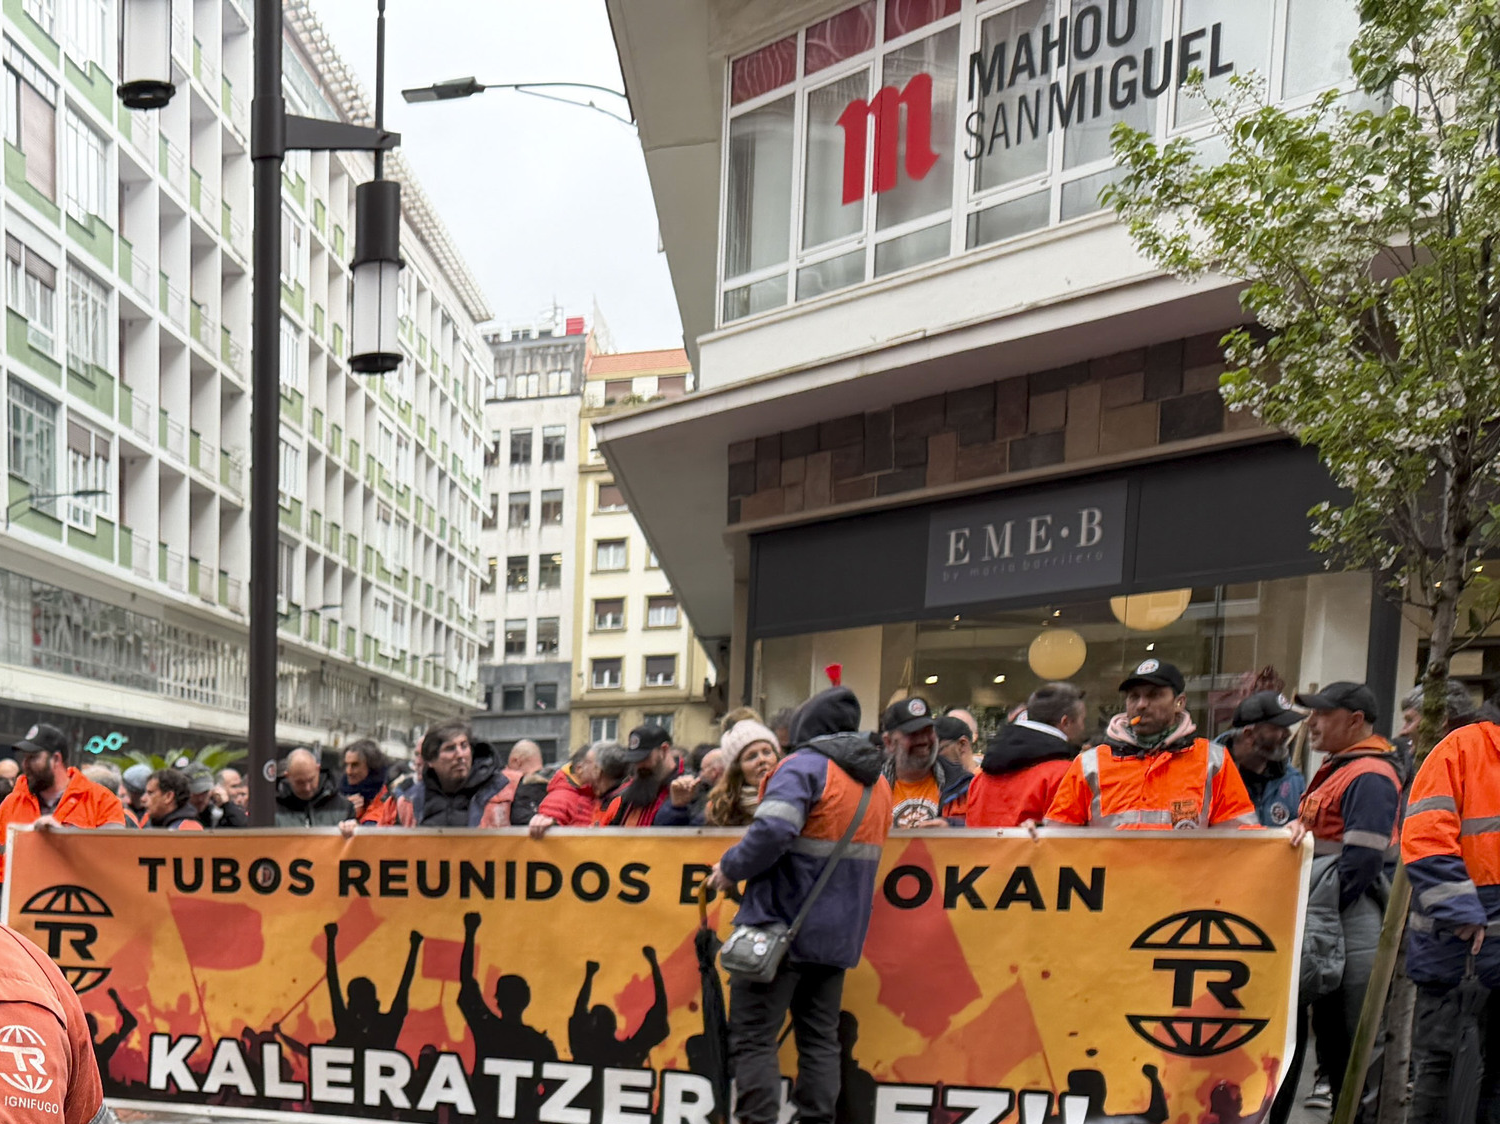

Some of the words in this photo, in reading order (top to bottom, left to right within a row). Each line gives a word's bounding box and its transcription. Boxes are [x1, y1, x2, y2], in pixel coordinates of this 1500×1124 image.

[967, 0, 1138, 101] MAHOU
[137, 856, 316, 897] TUBOS
[337, 858, 652, 905] REUNIDOS
[678, 862, 1108, 913] BOKAN
[4, 1095, 60, 1115] IGNIFUGO
